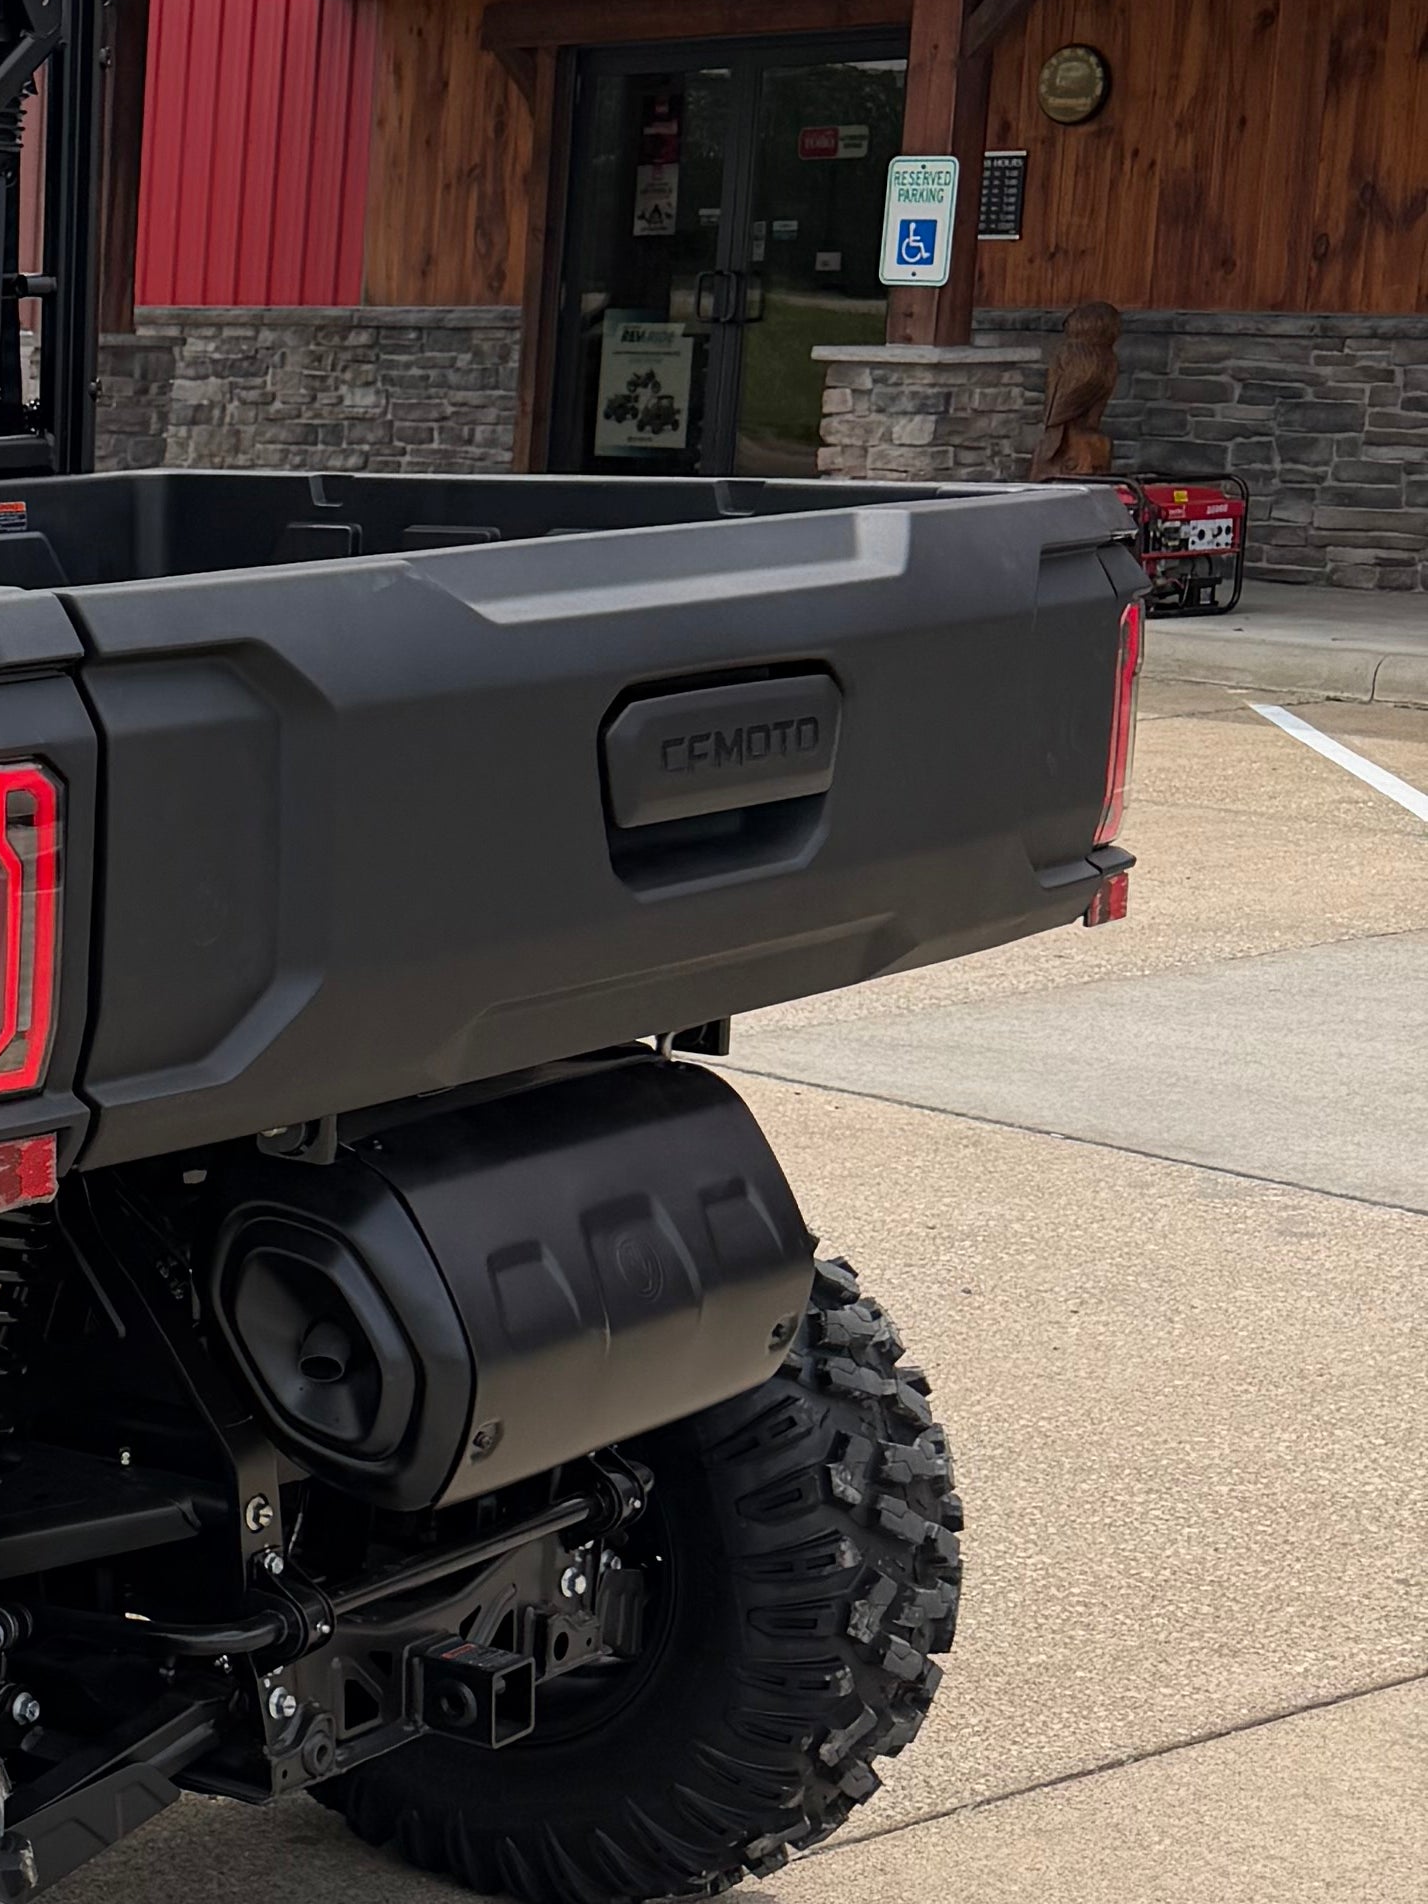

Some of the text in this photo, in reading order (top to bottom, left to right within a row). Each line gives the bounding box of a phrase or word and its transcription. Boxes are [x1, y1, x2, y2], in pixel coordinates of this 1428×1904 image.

[893, 170, 952, 187] RESERVED
[897, 188, 945, 203] PARKING
[660, 715, 820, 775] CFMOTO
